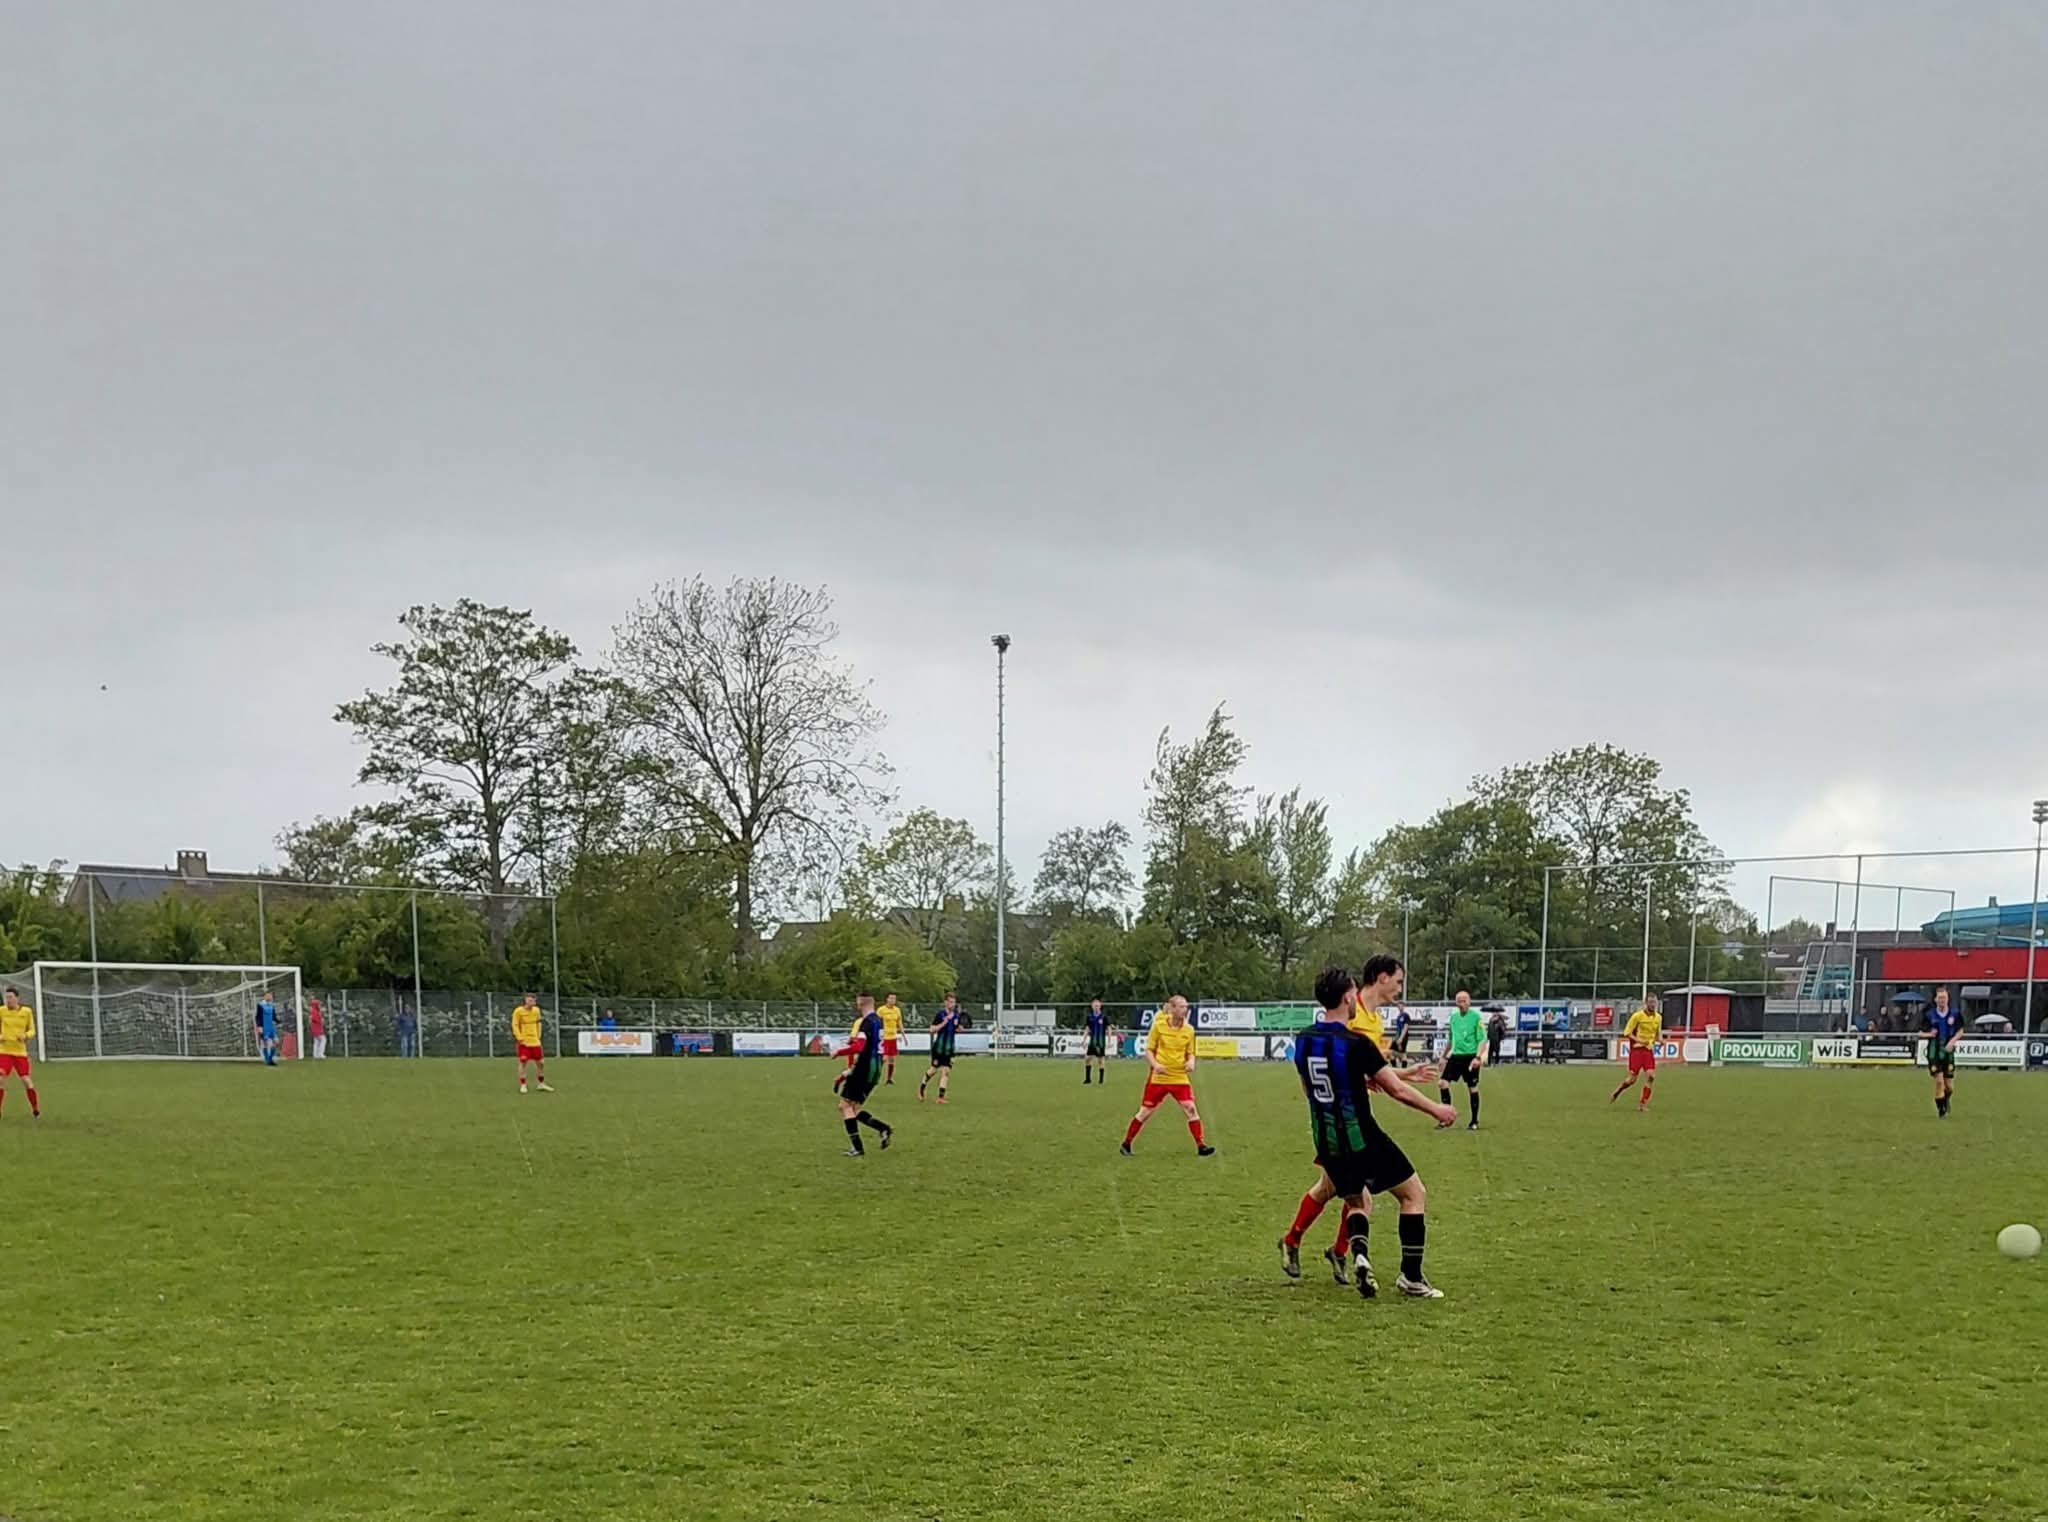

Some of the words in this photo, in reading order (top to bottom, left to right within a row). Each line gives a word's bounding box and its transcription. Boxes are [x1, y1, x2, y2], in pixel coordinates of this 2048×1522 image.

[1622, 1043, 1678, 1056] NRD
[1723, 1043, 1798, 1058] PROWURK
[1307, 1056, 1335, 1103] 5
